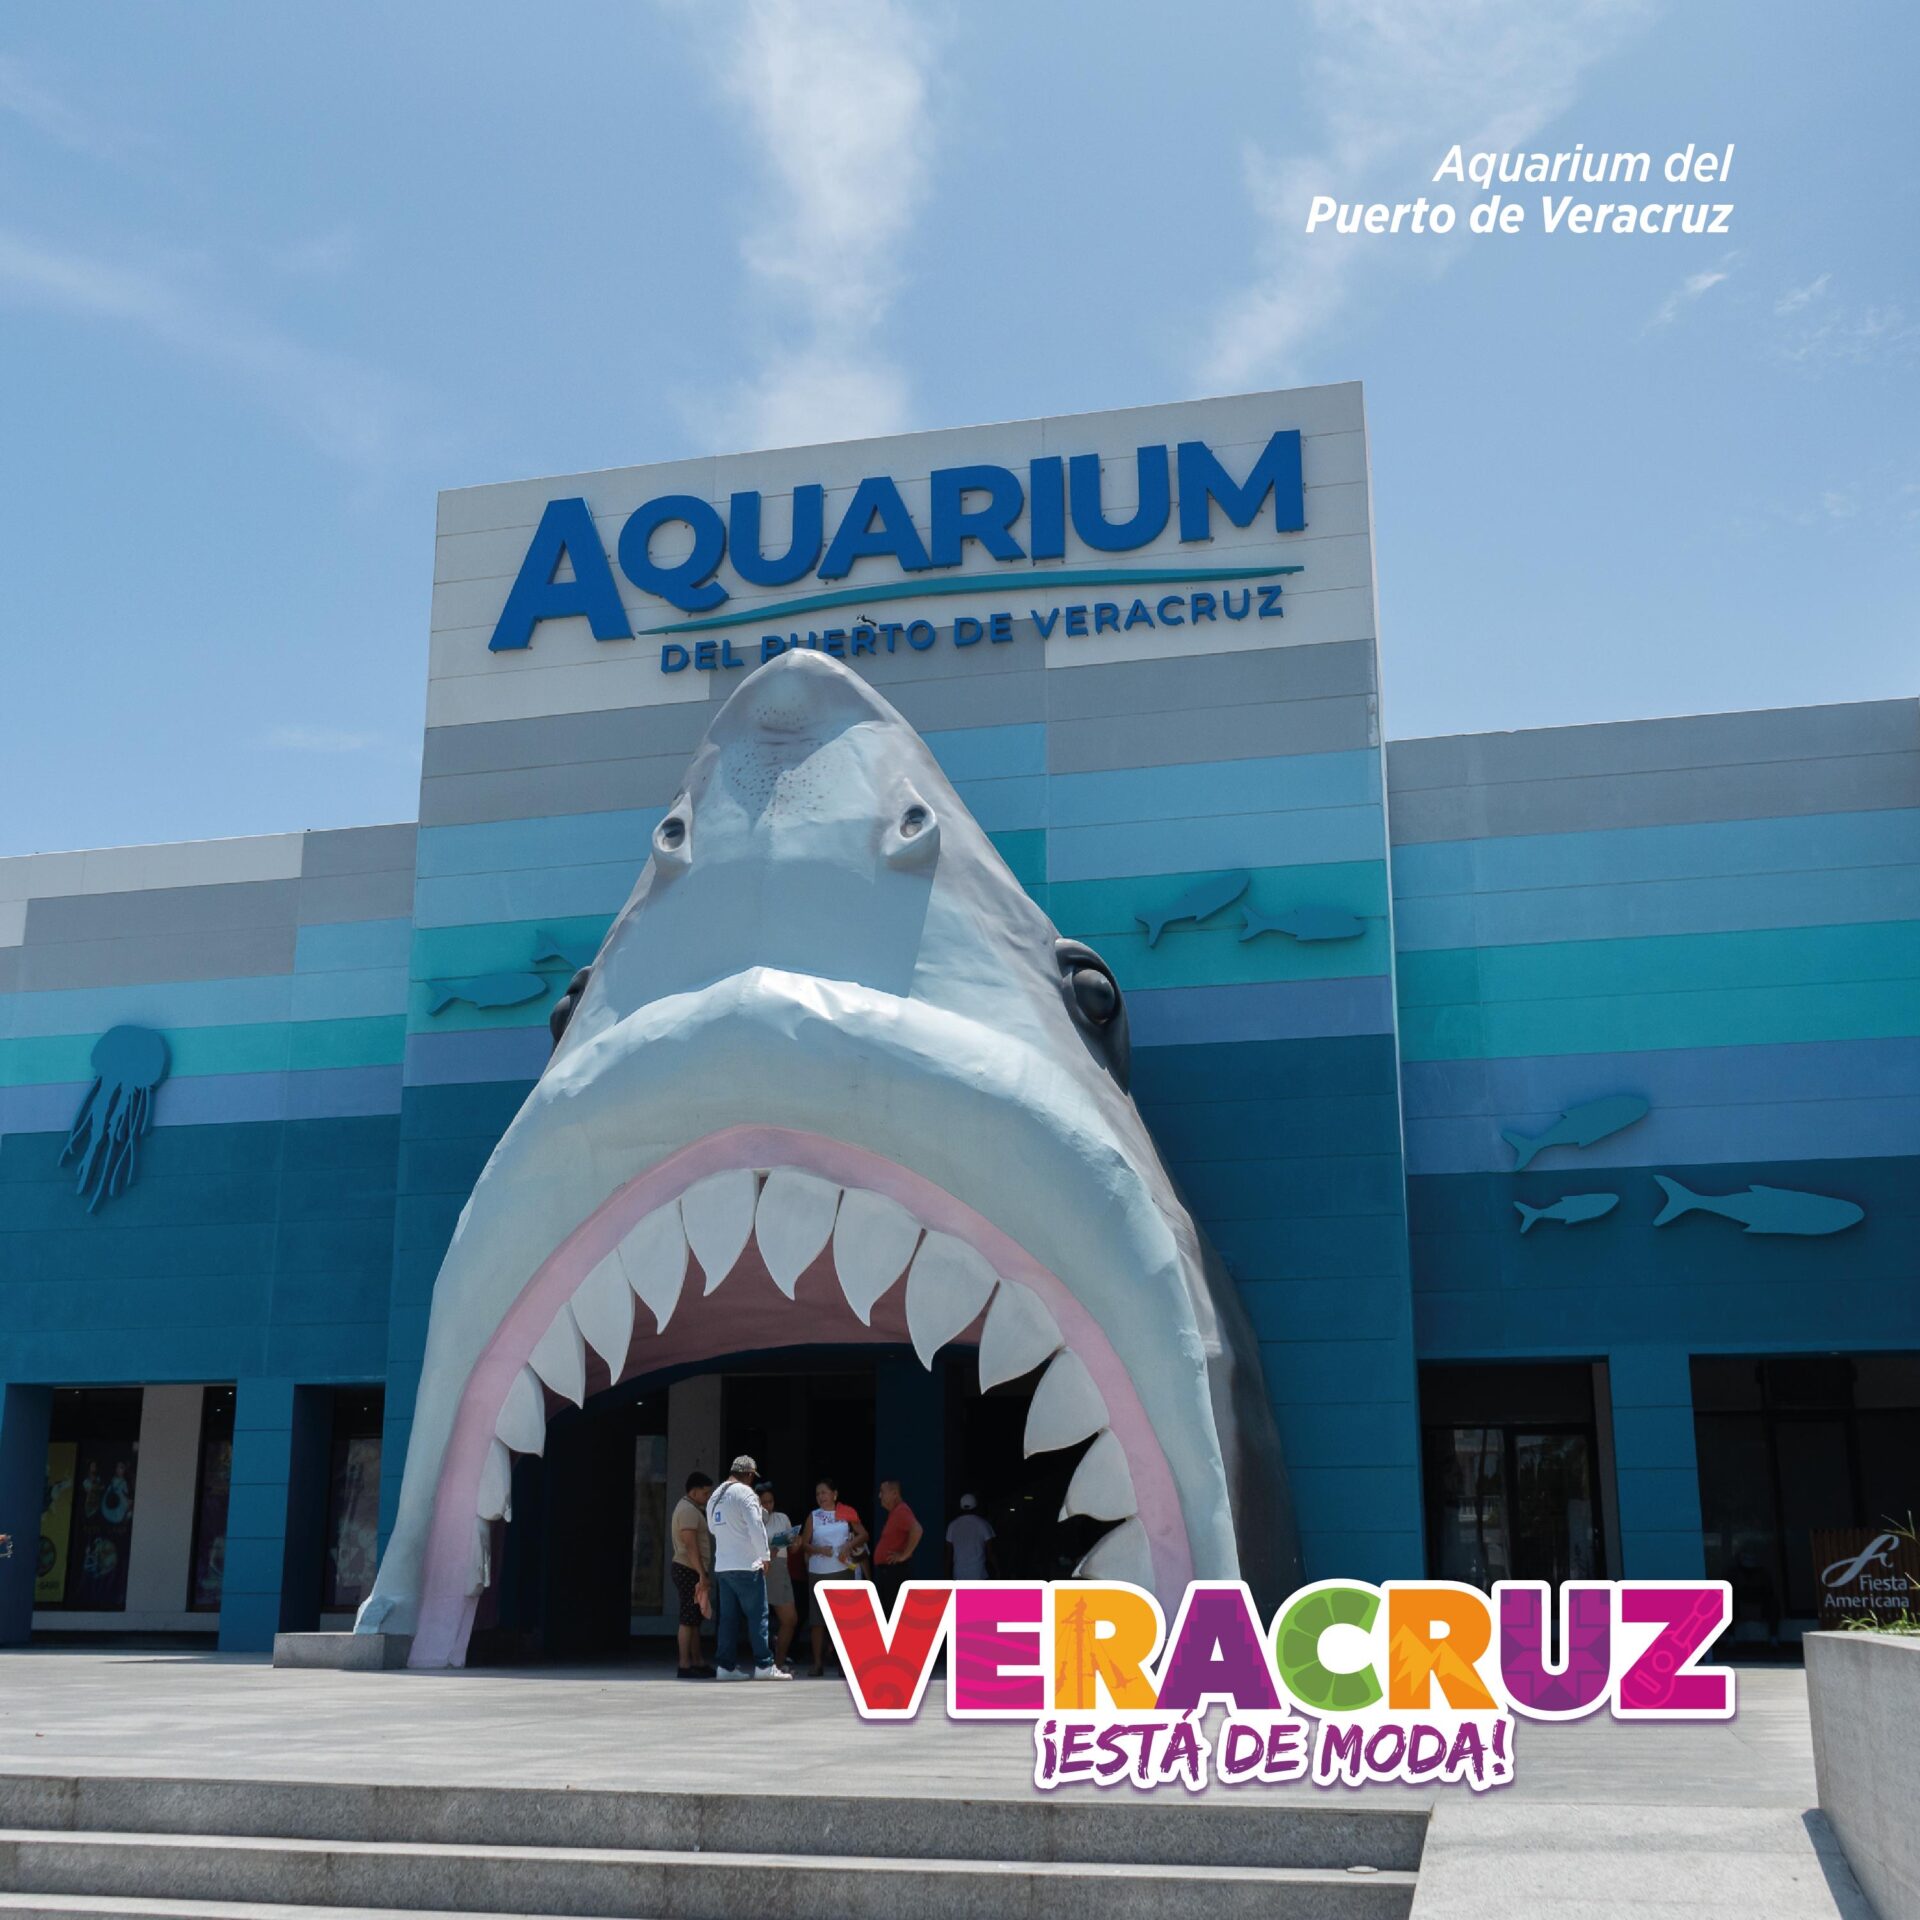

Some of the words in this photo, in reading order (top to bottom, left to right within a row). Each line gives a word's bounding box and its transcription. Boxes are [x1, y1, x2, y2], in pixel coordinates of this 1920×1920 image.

[488, 429, 1306, 652] AQUARIUM
[660, 639, 745, 674] DEL
[953, 613, 1014, 649] DE
[1031, 585, 1284, 639] VERACRUZ
[1824, 1593, 1910, 1609] Americana
[1859, 1574, 1908, 1591] Fiesta
